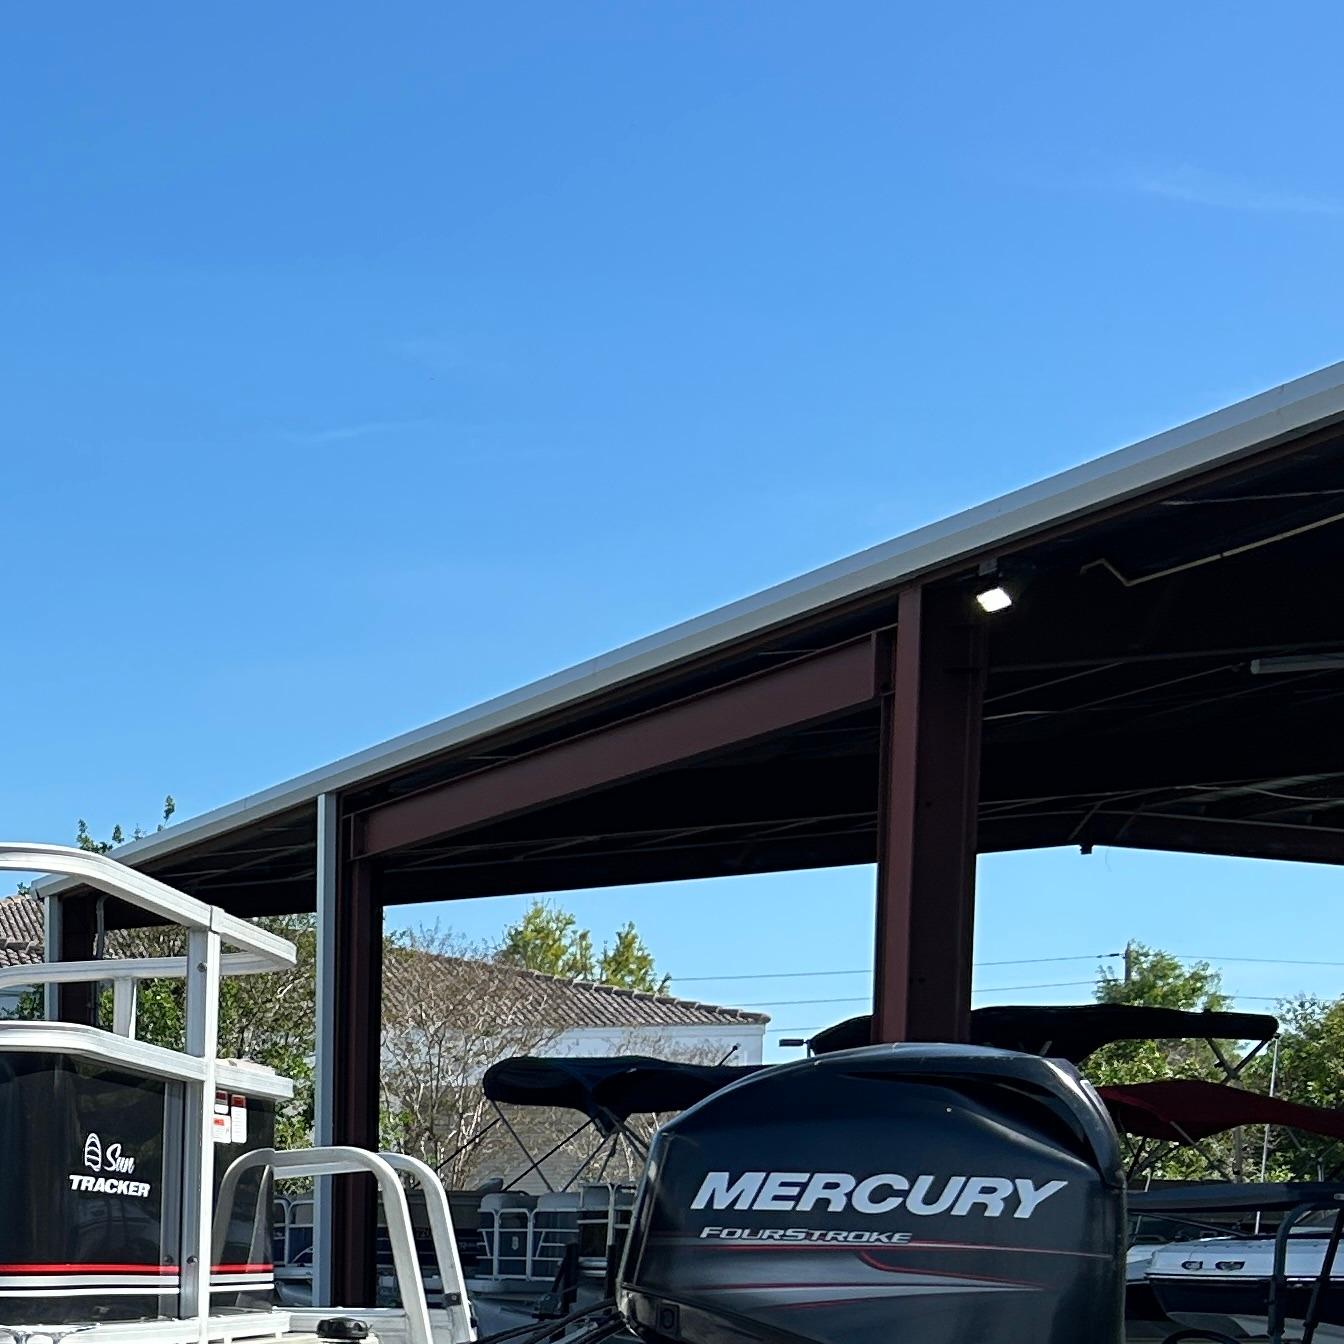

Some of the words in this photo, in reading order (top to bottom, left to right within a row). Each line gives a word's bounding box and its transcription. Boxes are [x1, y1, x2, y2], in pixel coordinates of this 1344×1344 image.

[103, 1143, 135, 1174] Sun
[69, 1174, 151, 1198] TRACKER
[689, 1171, 1069, 1219] MERCURY
